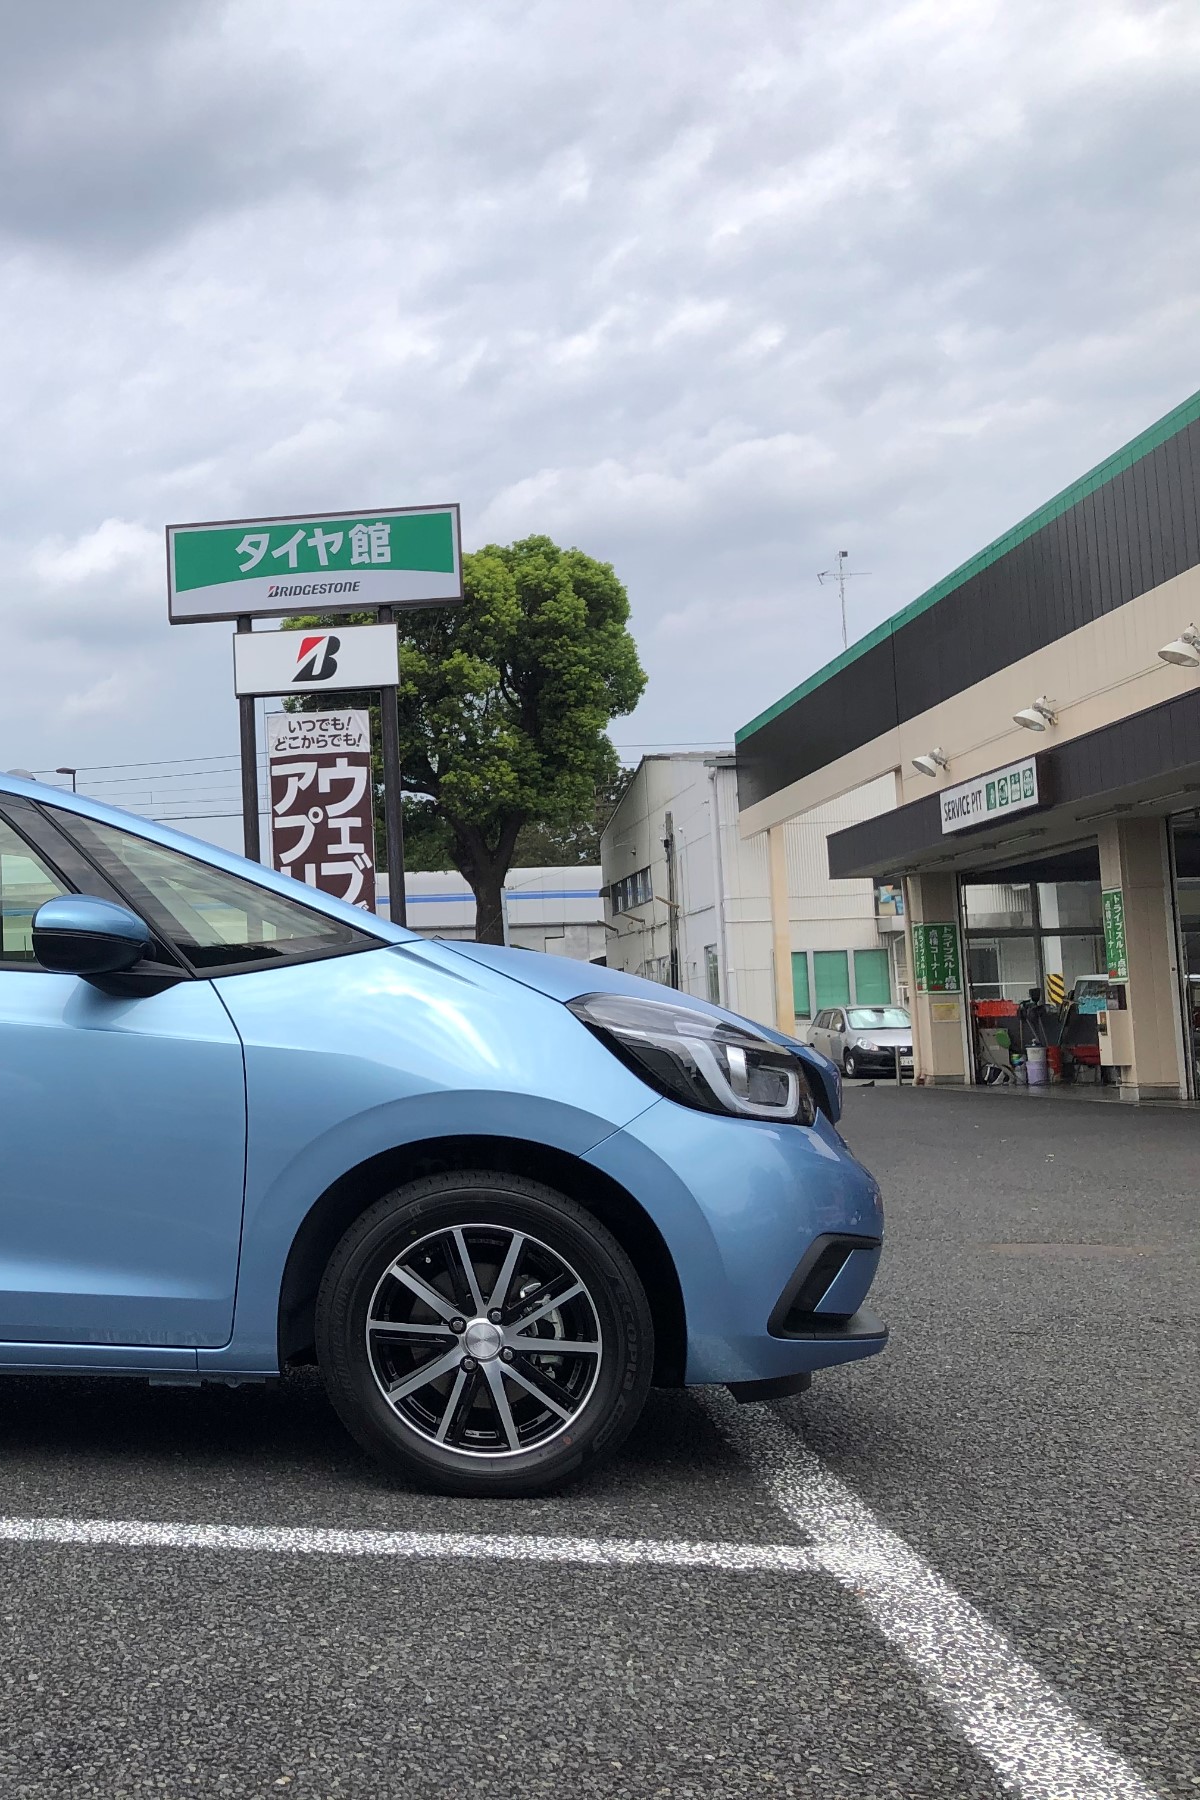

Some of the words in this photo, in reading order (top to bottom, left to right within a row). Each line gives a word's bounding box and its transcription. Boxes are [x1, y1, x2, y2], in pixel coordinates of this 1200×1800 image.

[235, 521, 392, 573] タイヤ館
[267, 581, 361, 598] BRIDGESTONE
[287, 716, 352, 734] いつでも!
[274, 733, 363, 752] どこからでも!
[943, 794, 971, 822] SERVICE
[971, 789, 982, 813] PIT
[317, 757, 373, 911] ウェブ
